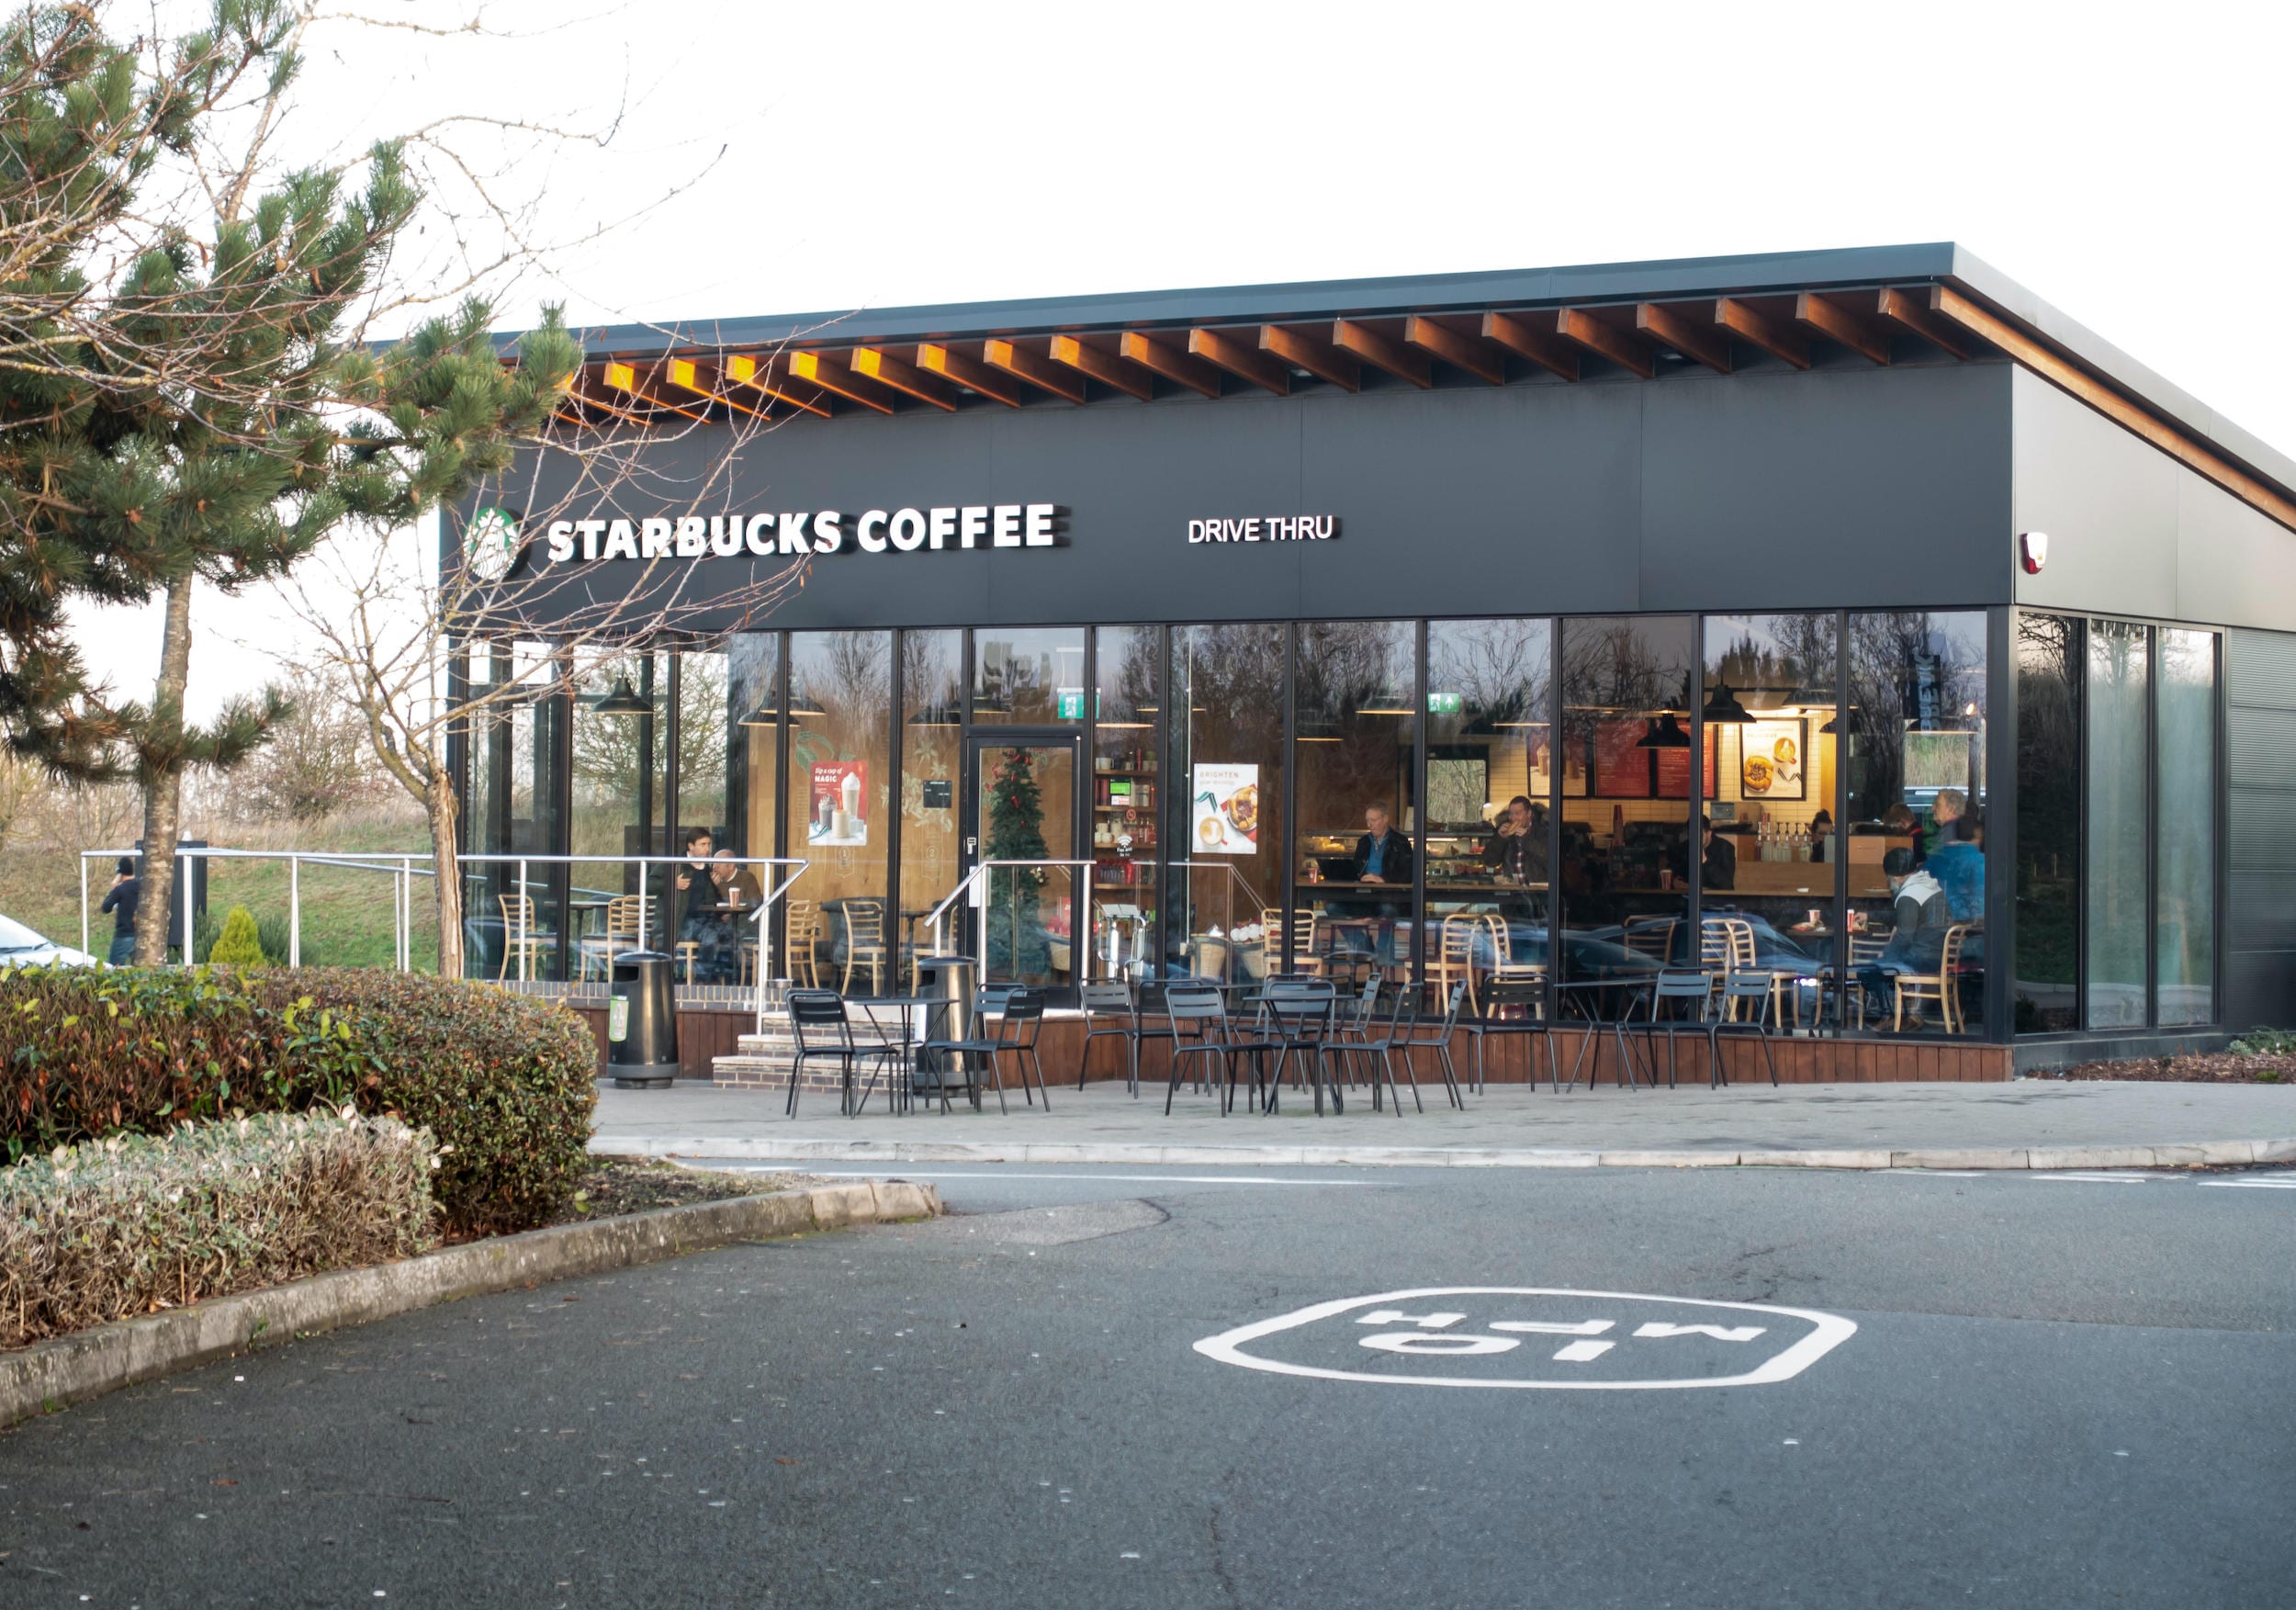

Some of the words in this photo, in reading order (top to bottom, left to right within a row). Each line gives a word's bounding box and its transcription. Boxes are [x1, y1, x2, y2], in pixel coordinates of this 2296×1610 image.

[547, 512, 841, 562] STARBUCKS
[857, 503, 1053, 553] COFFEE
[1188, 518, 1260, 544] DRIVE
[1265, 514, 1334, 541] THRU
[1355, 1310, 1767, 1342] MPH
[1358, 1332, 1616, 1362] 10
